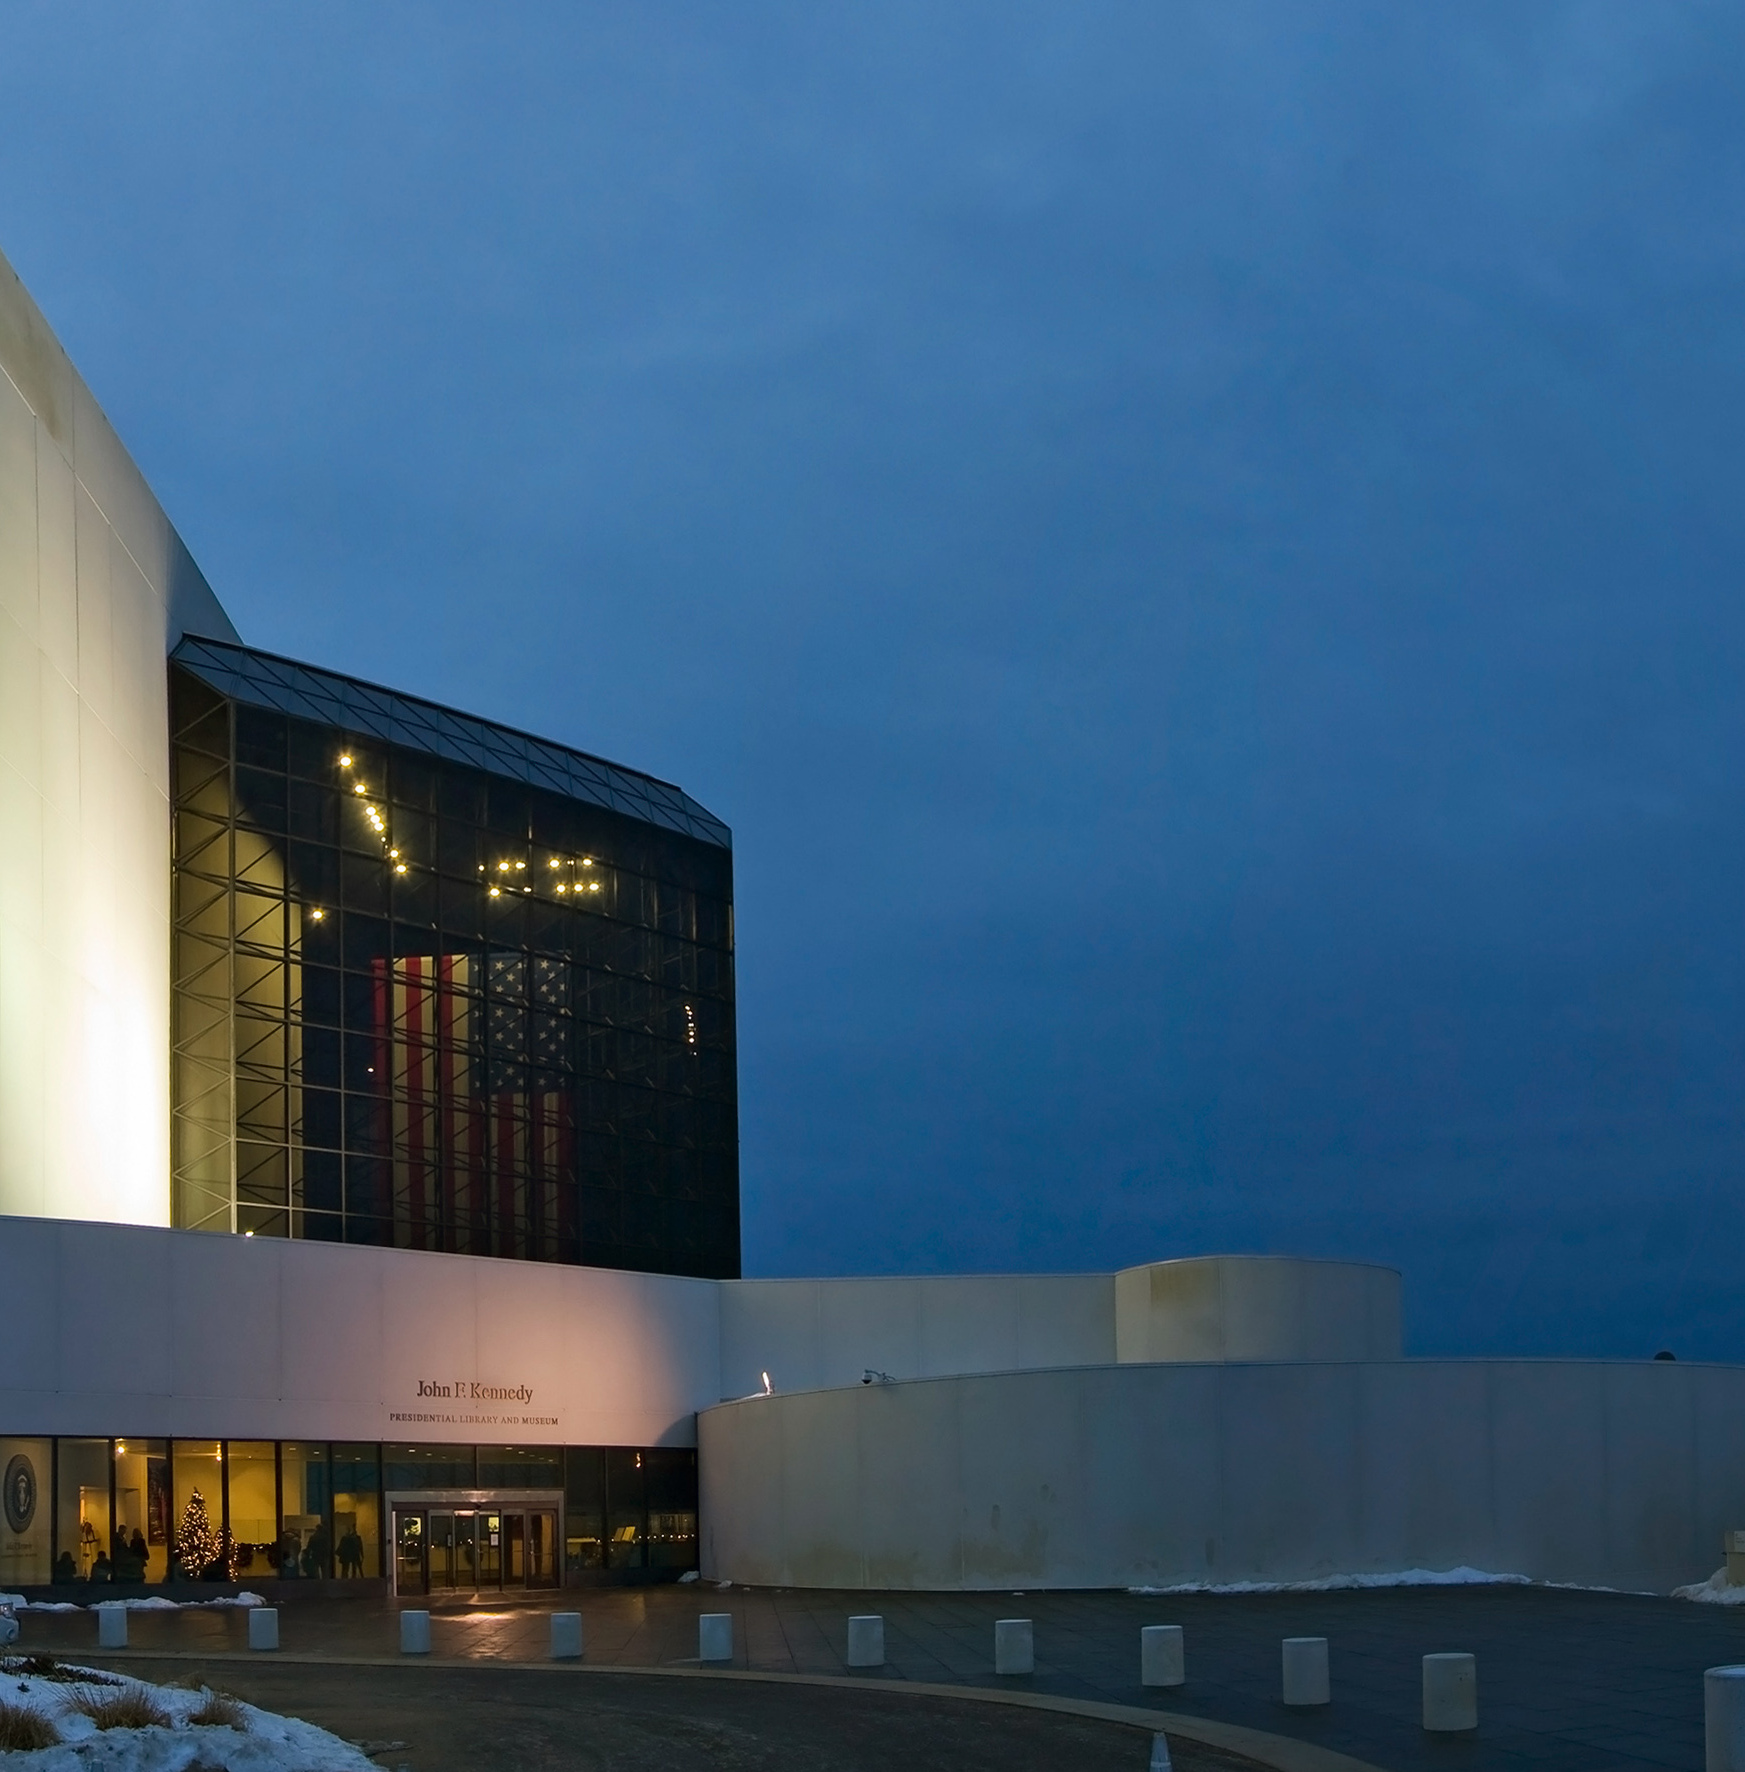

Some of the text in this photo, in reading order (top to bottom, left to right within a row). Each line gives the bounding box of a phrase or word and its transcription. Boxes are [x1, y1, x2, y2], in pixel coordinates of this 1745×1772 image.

[417, 1380, 533, 1404] John F. Kennedy
[390, 1413, 558, 1425] PRESIDENTIAL LIBRARY AND MUSEUM
